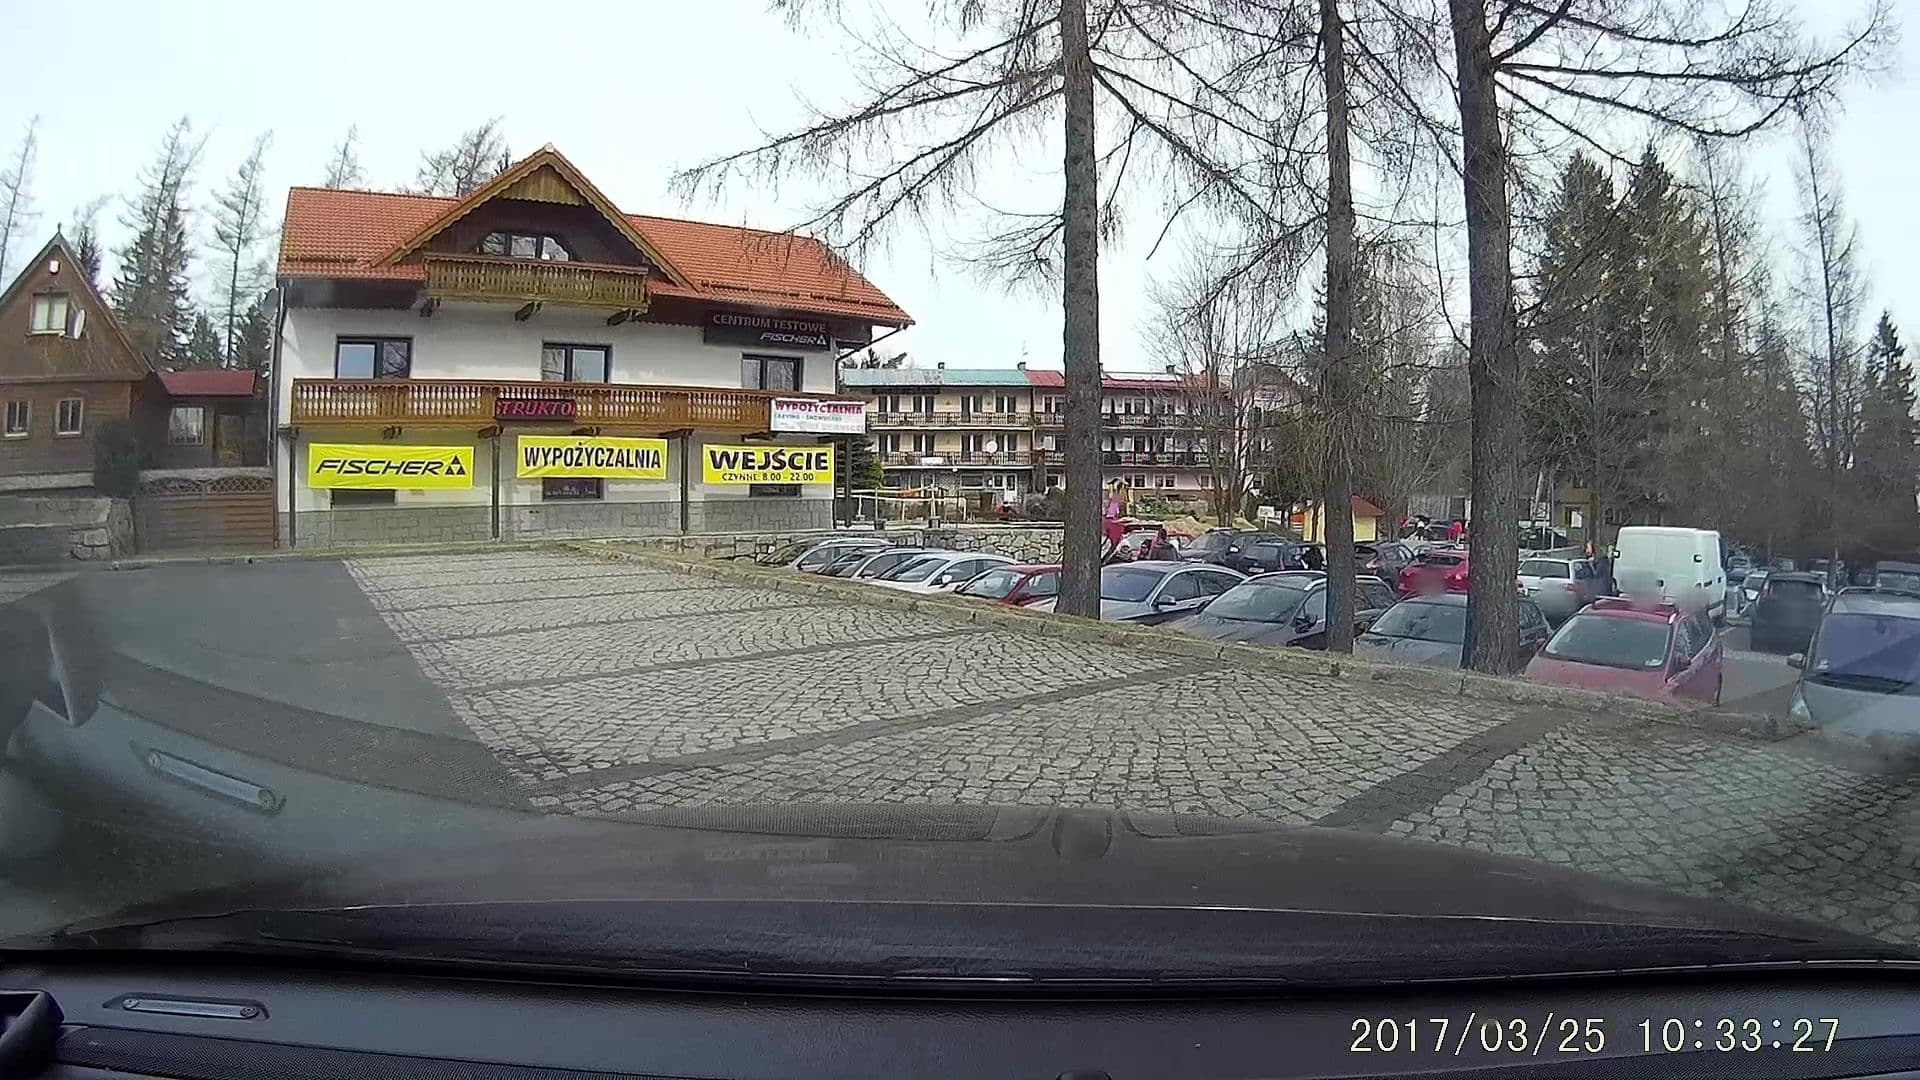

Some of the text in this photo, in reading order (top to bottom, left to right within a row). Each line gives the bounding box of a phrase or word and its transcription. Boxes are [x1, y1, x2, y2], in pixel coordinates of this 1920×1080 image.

[713, 314, 826, 333] CENTRUM TESTOWE
[760, 332, 817, 345] FISCHER
[524, 442, 662, 469] WYPOŻYCZALNIA
[709, 449, 829, 471] WEJŚCIE
[316, 459, 446, 476] FISCHER
[790, 473, 815, 482] 22.00
